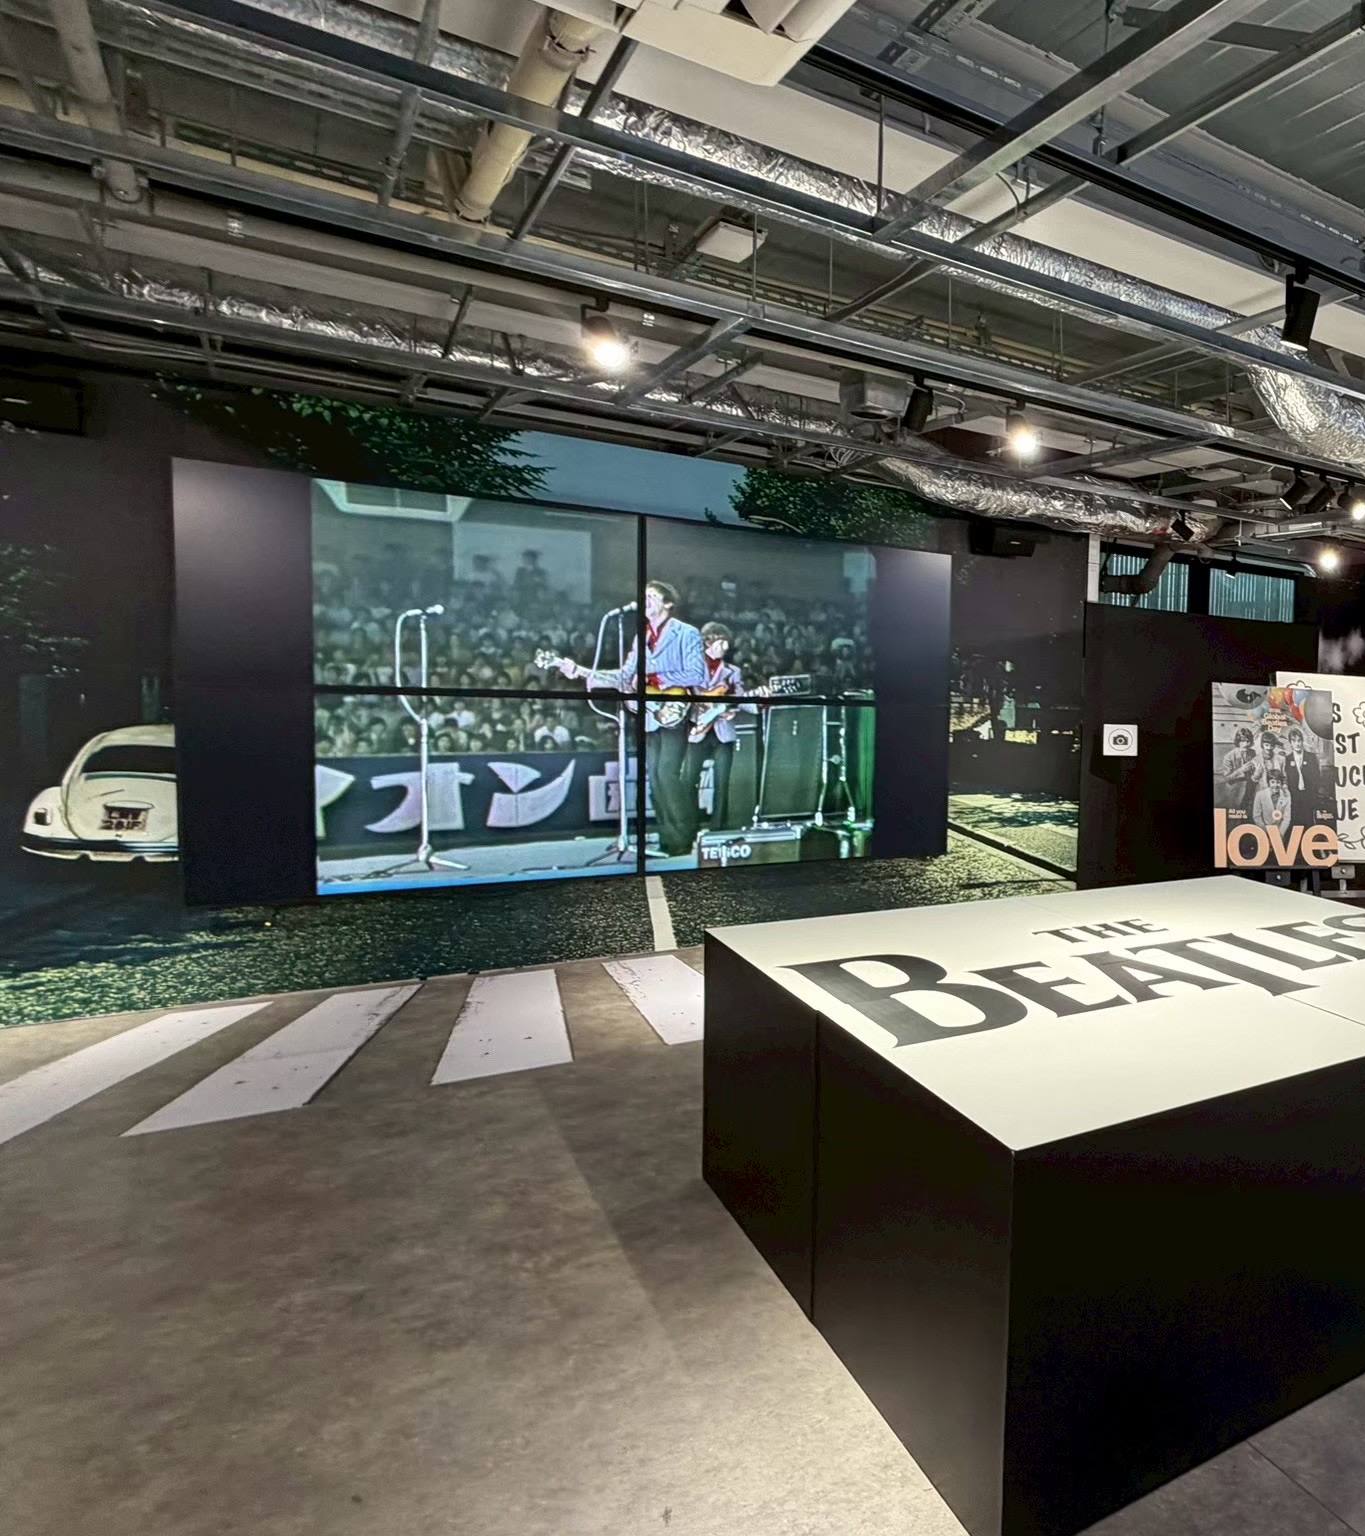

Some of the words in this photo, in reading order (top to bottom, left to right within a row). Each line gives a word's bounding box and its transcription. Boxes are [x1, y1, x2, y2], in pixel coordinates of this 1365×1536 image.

[1335, 731, 1360, 754] ST
[1336, 797, 1360, 821] UE
[1213, 807, 1338, 868] love
[1031, 917, 1171, 945] THE
